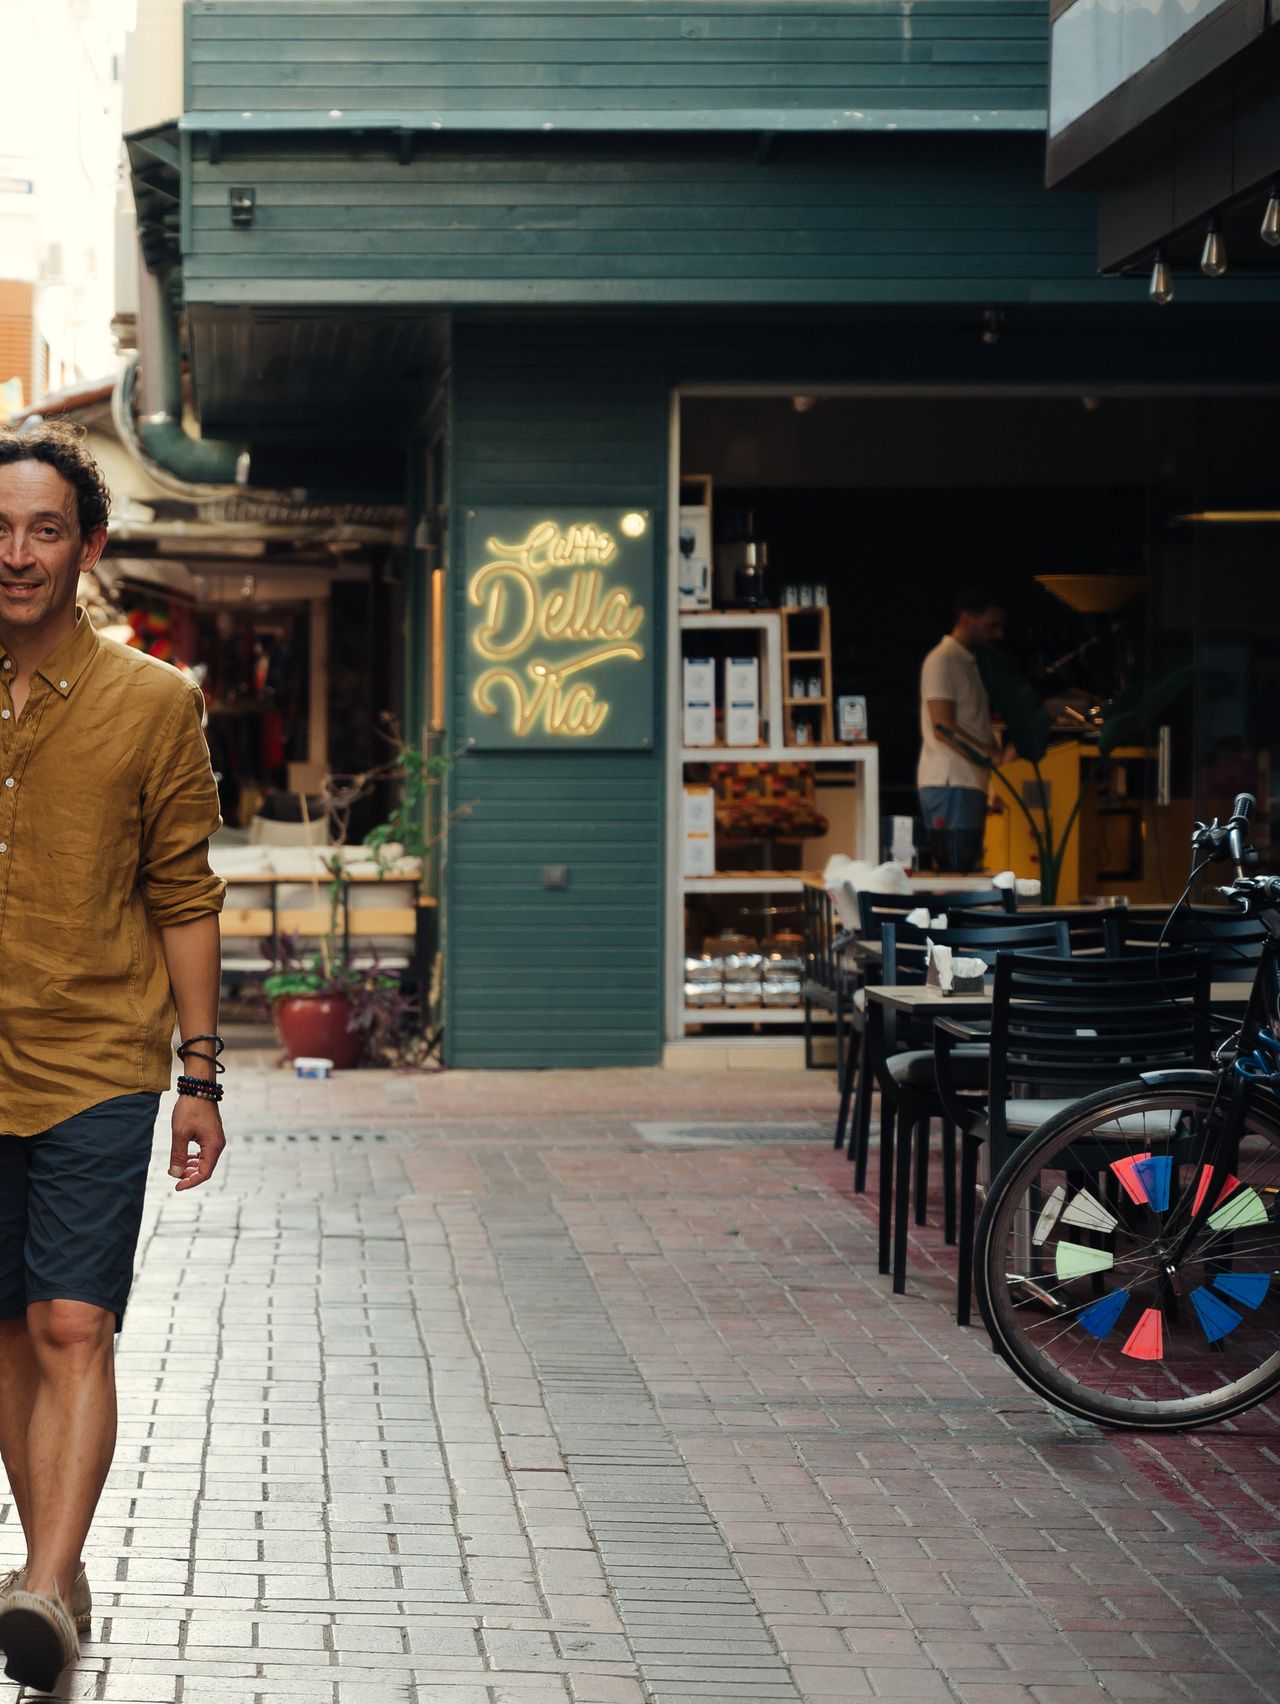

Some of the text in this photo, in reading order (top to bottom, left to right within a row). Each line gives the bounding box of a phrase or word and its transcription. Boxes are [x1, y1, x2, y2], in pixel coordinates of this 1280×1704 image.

[486, 520, 617, 569] Caffe
[469, 560, 645, 661] Della
[472, 640, 644, 737] Via
